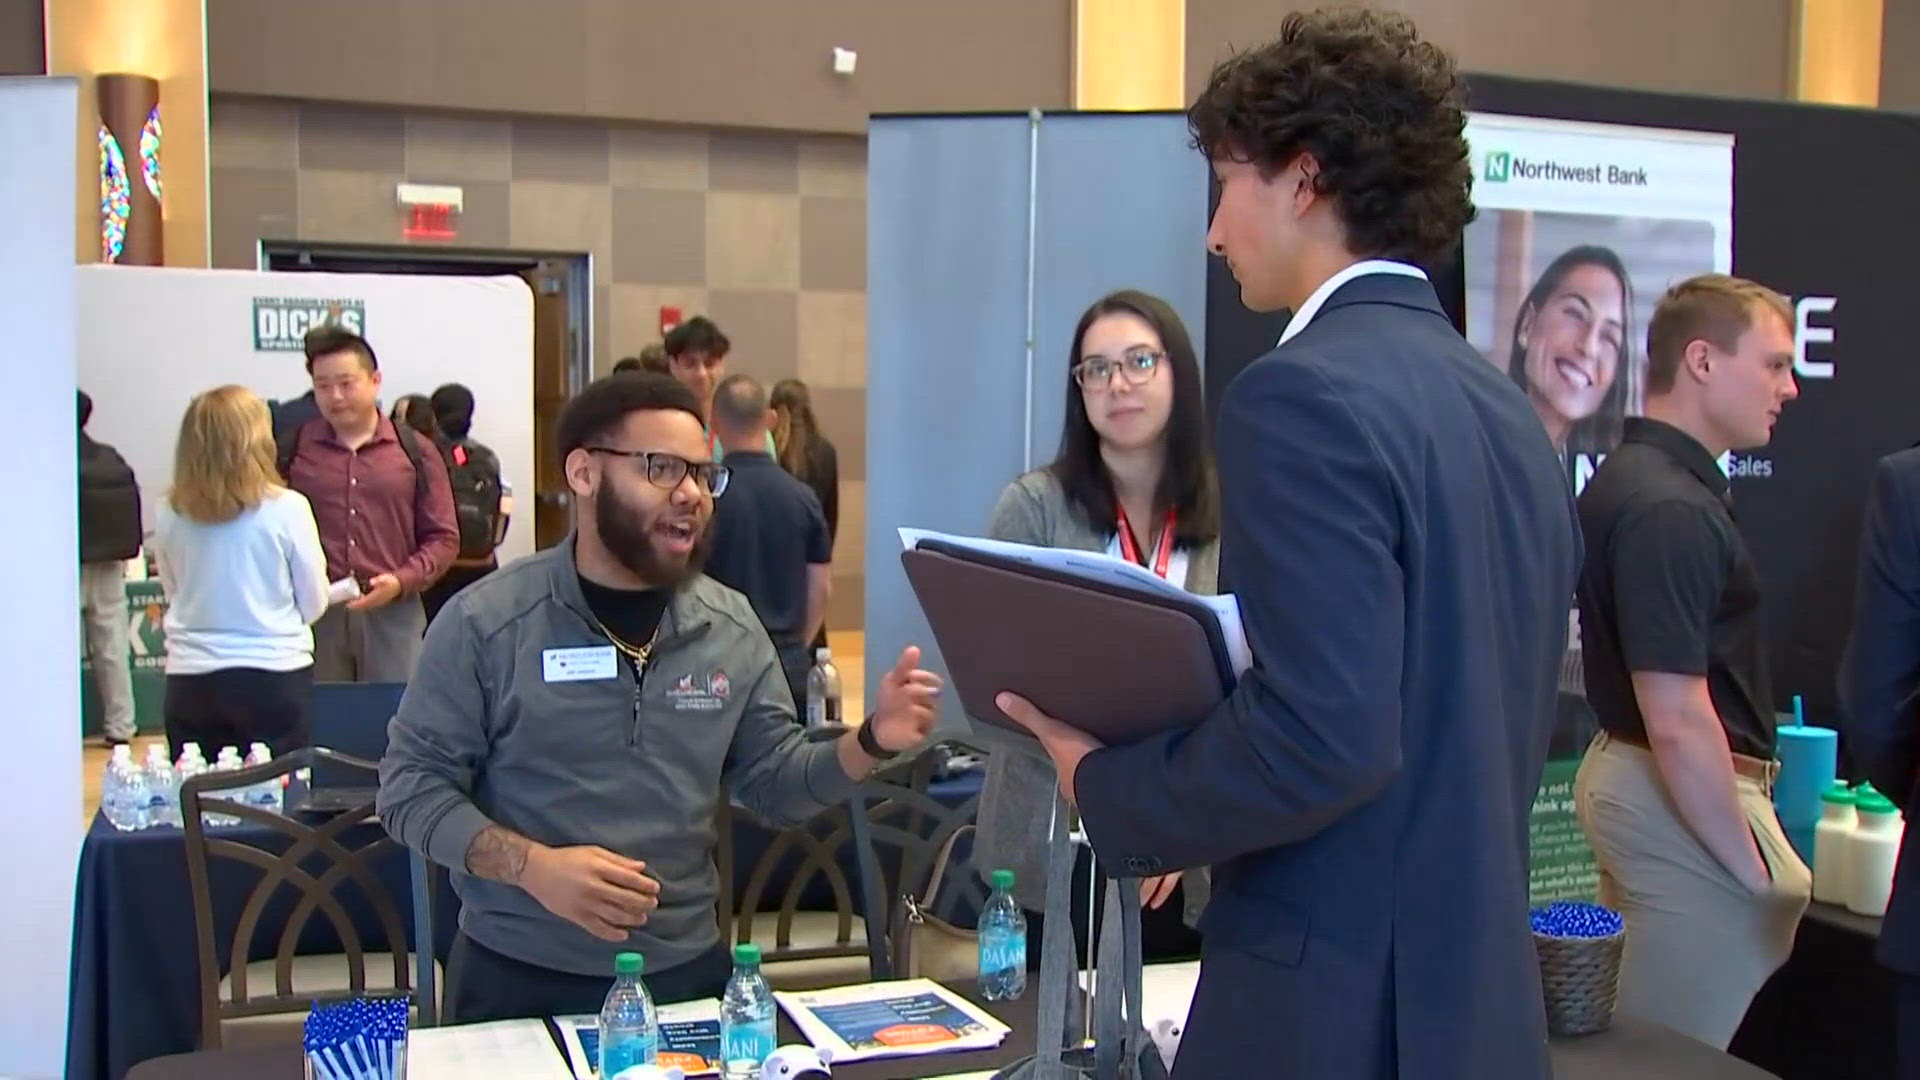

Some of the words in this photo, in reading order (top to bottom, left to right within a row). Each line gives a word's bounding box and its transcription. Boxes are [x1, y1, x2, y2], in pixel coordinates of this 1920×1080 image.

[1513, 157, 1601, 184] Northwest
[1608, 167, 1648, 187] Bank
[259, 308, 360, 340] DICK'S
[1794, 296, 1838, 378] E
[1728, 454, 1773, 478] Sales
[1549, 781, 1569, 796] not
[1532, 798, 1559, 814] hink
[1561, 800, 1576, 814] ag
[983, 946, 1026, 969] DASAN
